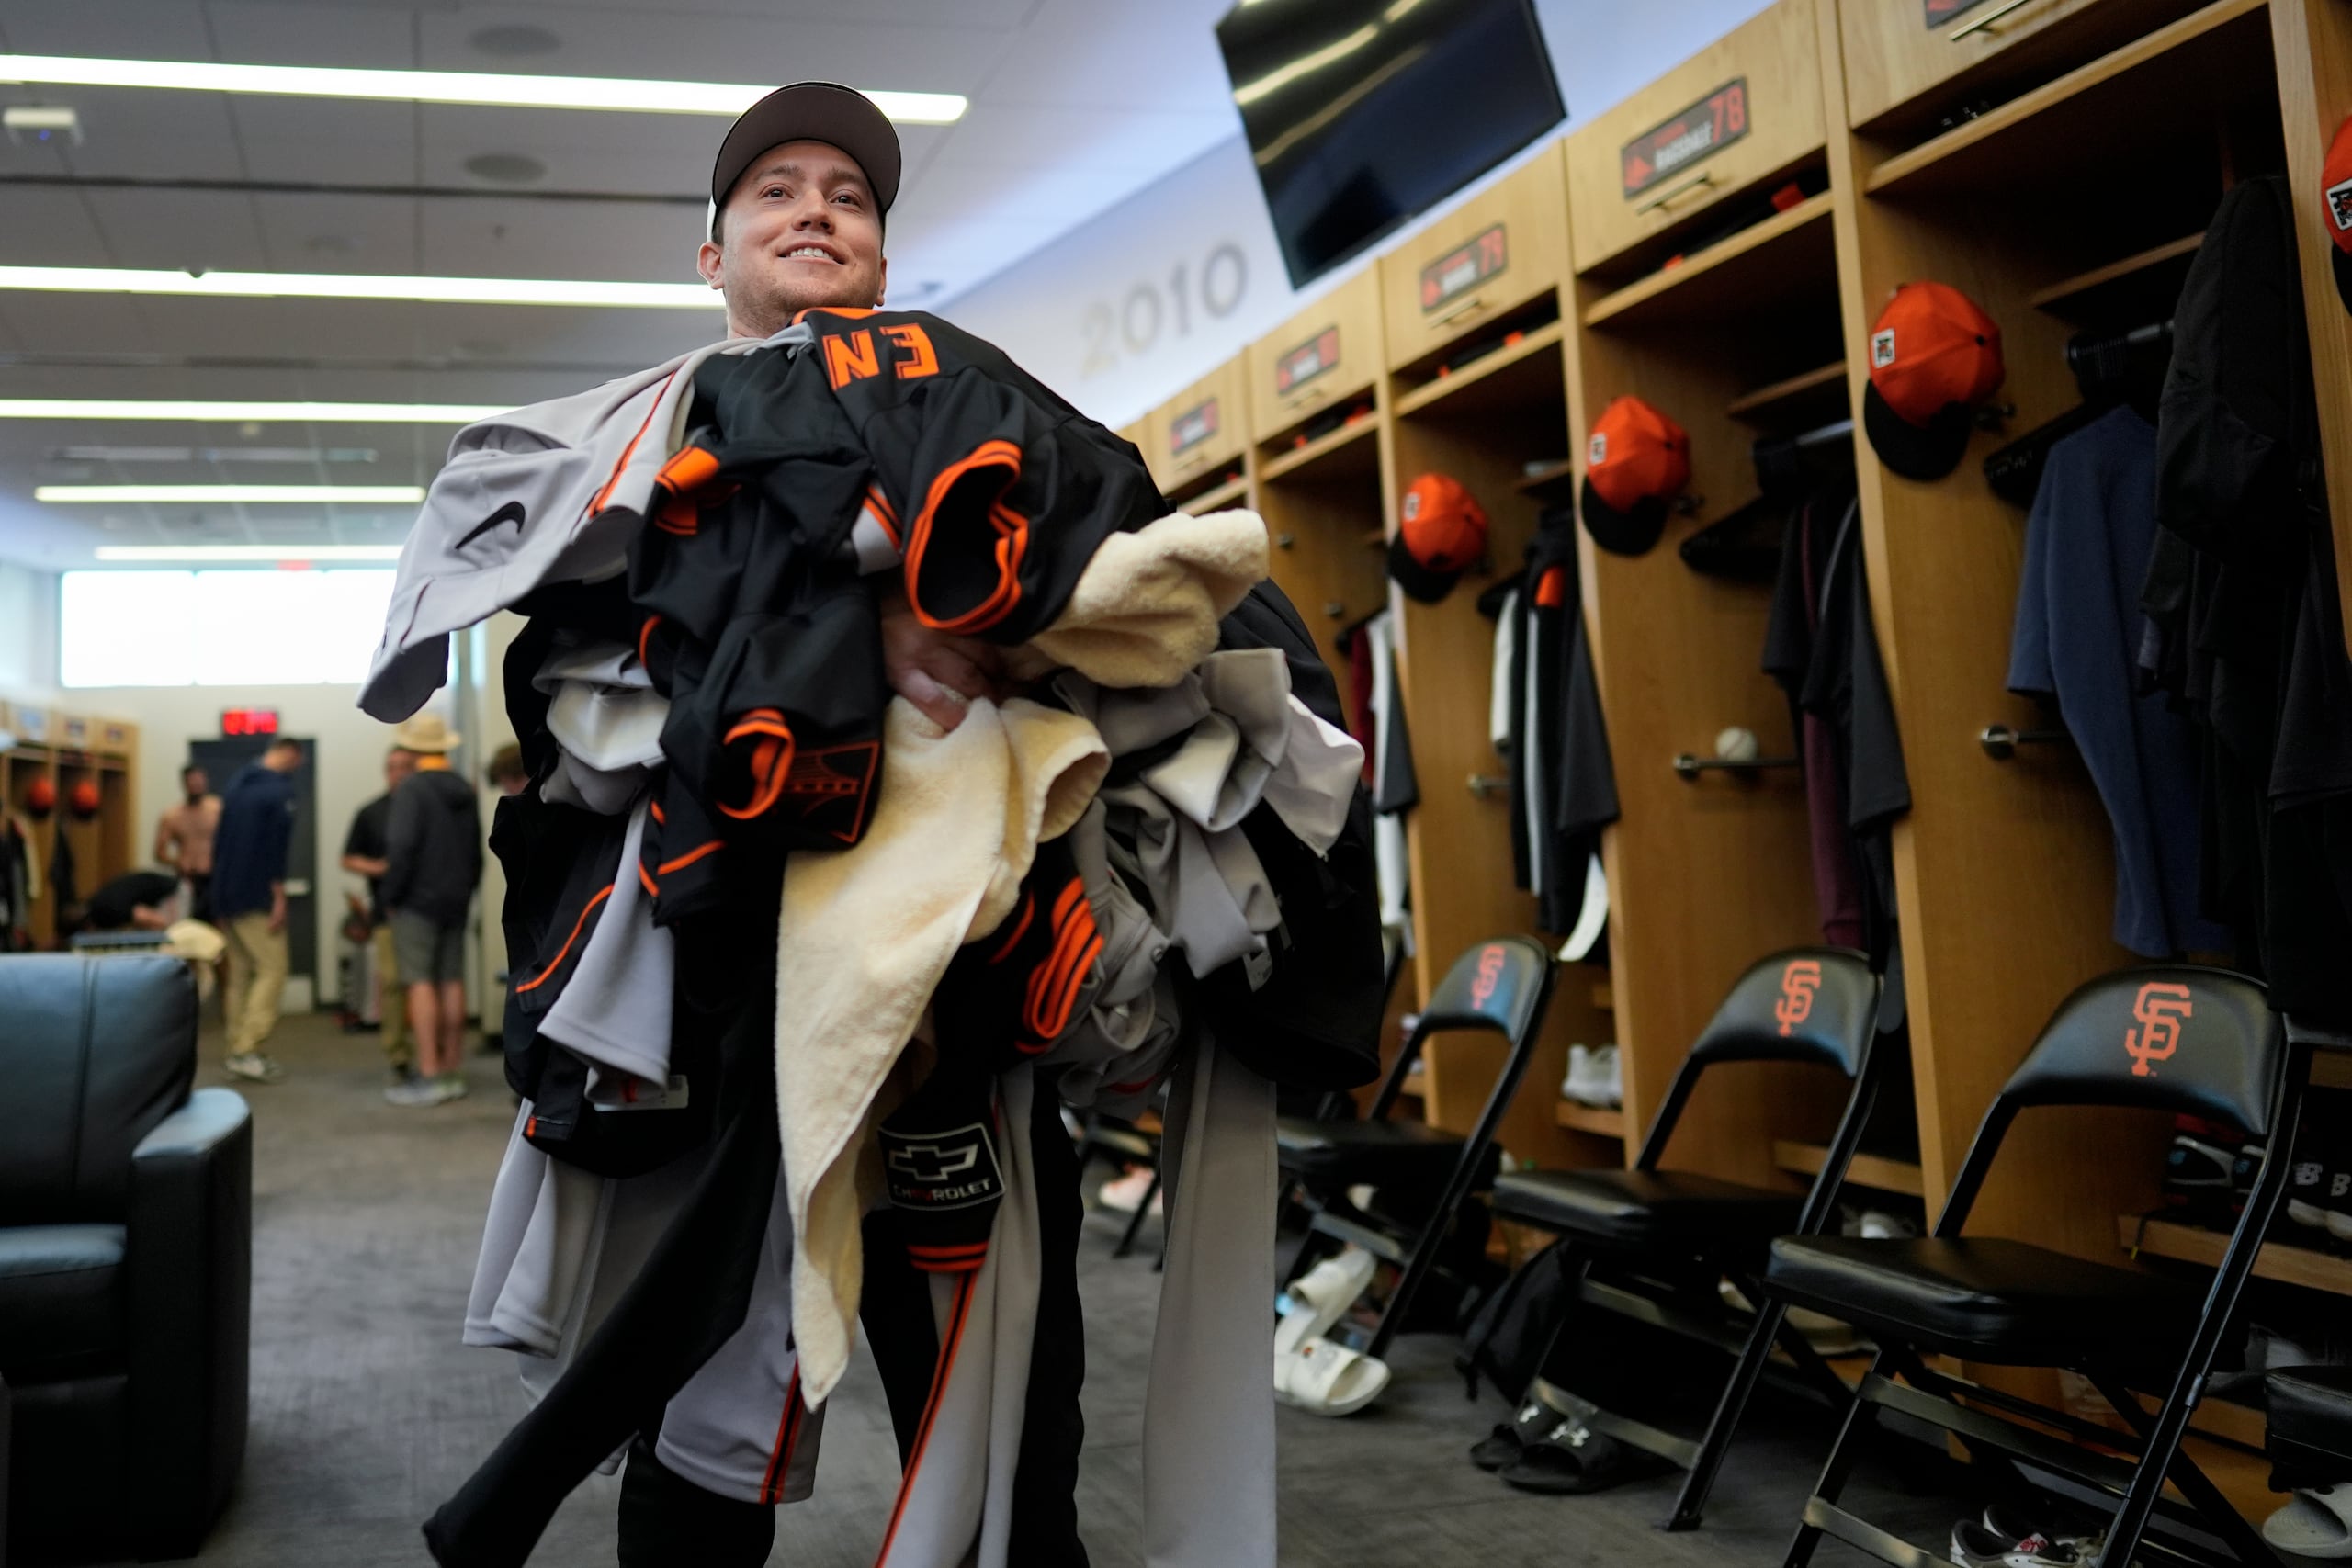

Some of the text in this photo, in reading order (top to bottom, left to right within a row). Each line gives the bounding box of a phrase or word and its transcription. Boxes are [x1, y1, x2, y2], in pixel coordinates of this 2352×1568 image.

[1708, 85, 1745, 145] 78
[1079, 243, 1249, 381] 2010
[1775, 960, 1822, 1037] SF
[2125, 982, 2193, 1077] SF
